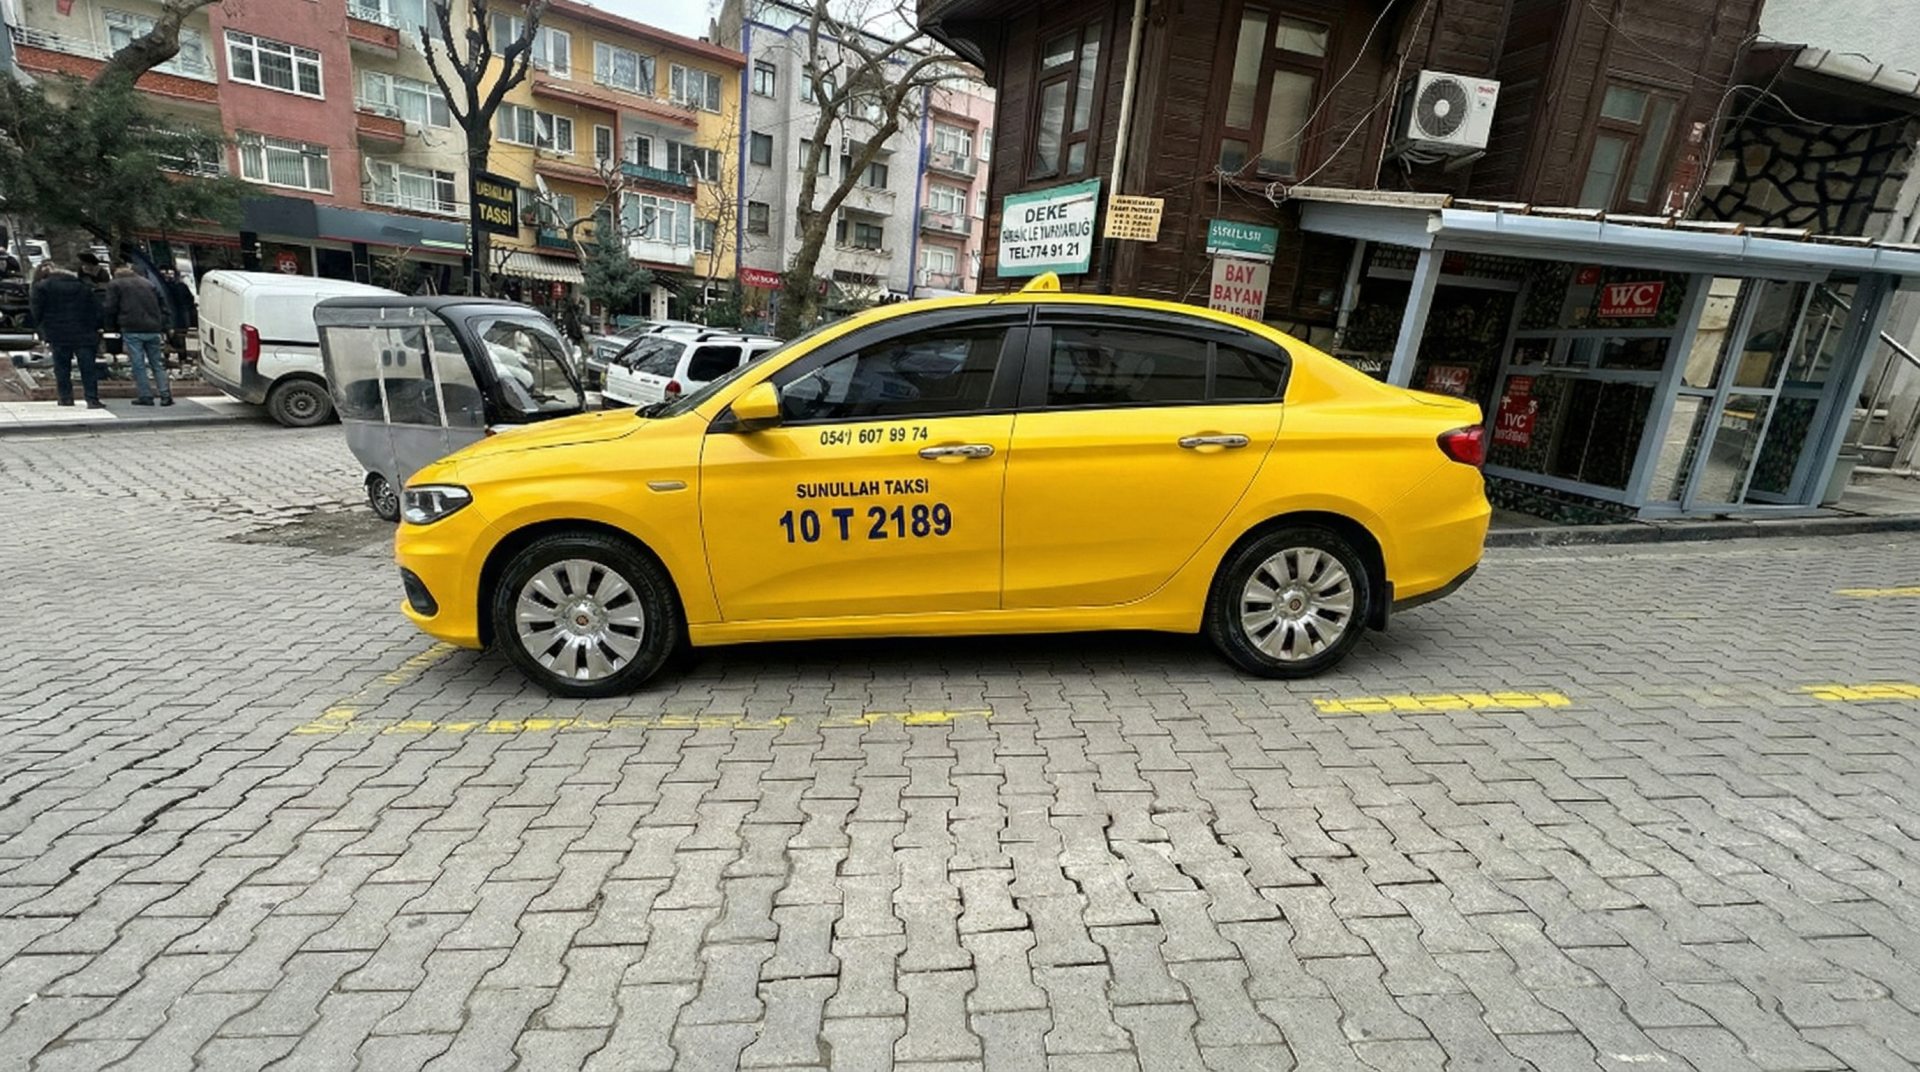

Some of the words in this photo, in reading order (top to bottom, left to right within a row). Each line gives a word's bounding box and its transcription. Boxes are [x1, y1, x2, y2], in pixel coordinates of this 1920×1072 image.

[1025, 204, 1068, 223] DEKE
[1050, 243, 1063, 257] 91
[1066, 242, 1079, 256] 21
[1226, 264, 1255, 284] BAY
[1213, 285, 1263, 306] BAYAN
[1611, 285, 1654, 306] WC
[858, 429, 884, 444] 607
[889, 427, 906, 442] 99
[912, 426, 928, 441] 74
[796, 481, 880, 499] SUNULLAH
[779, 509, 821, 544] 10
[832, 508, 854, 541] T
[867, 503, 952, 540] 2189
